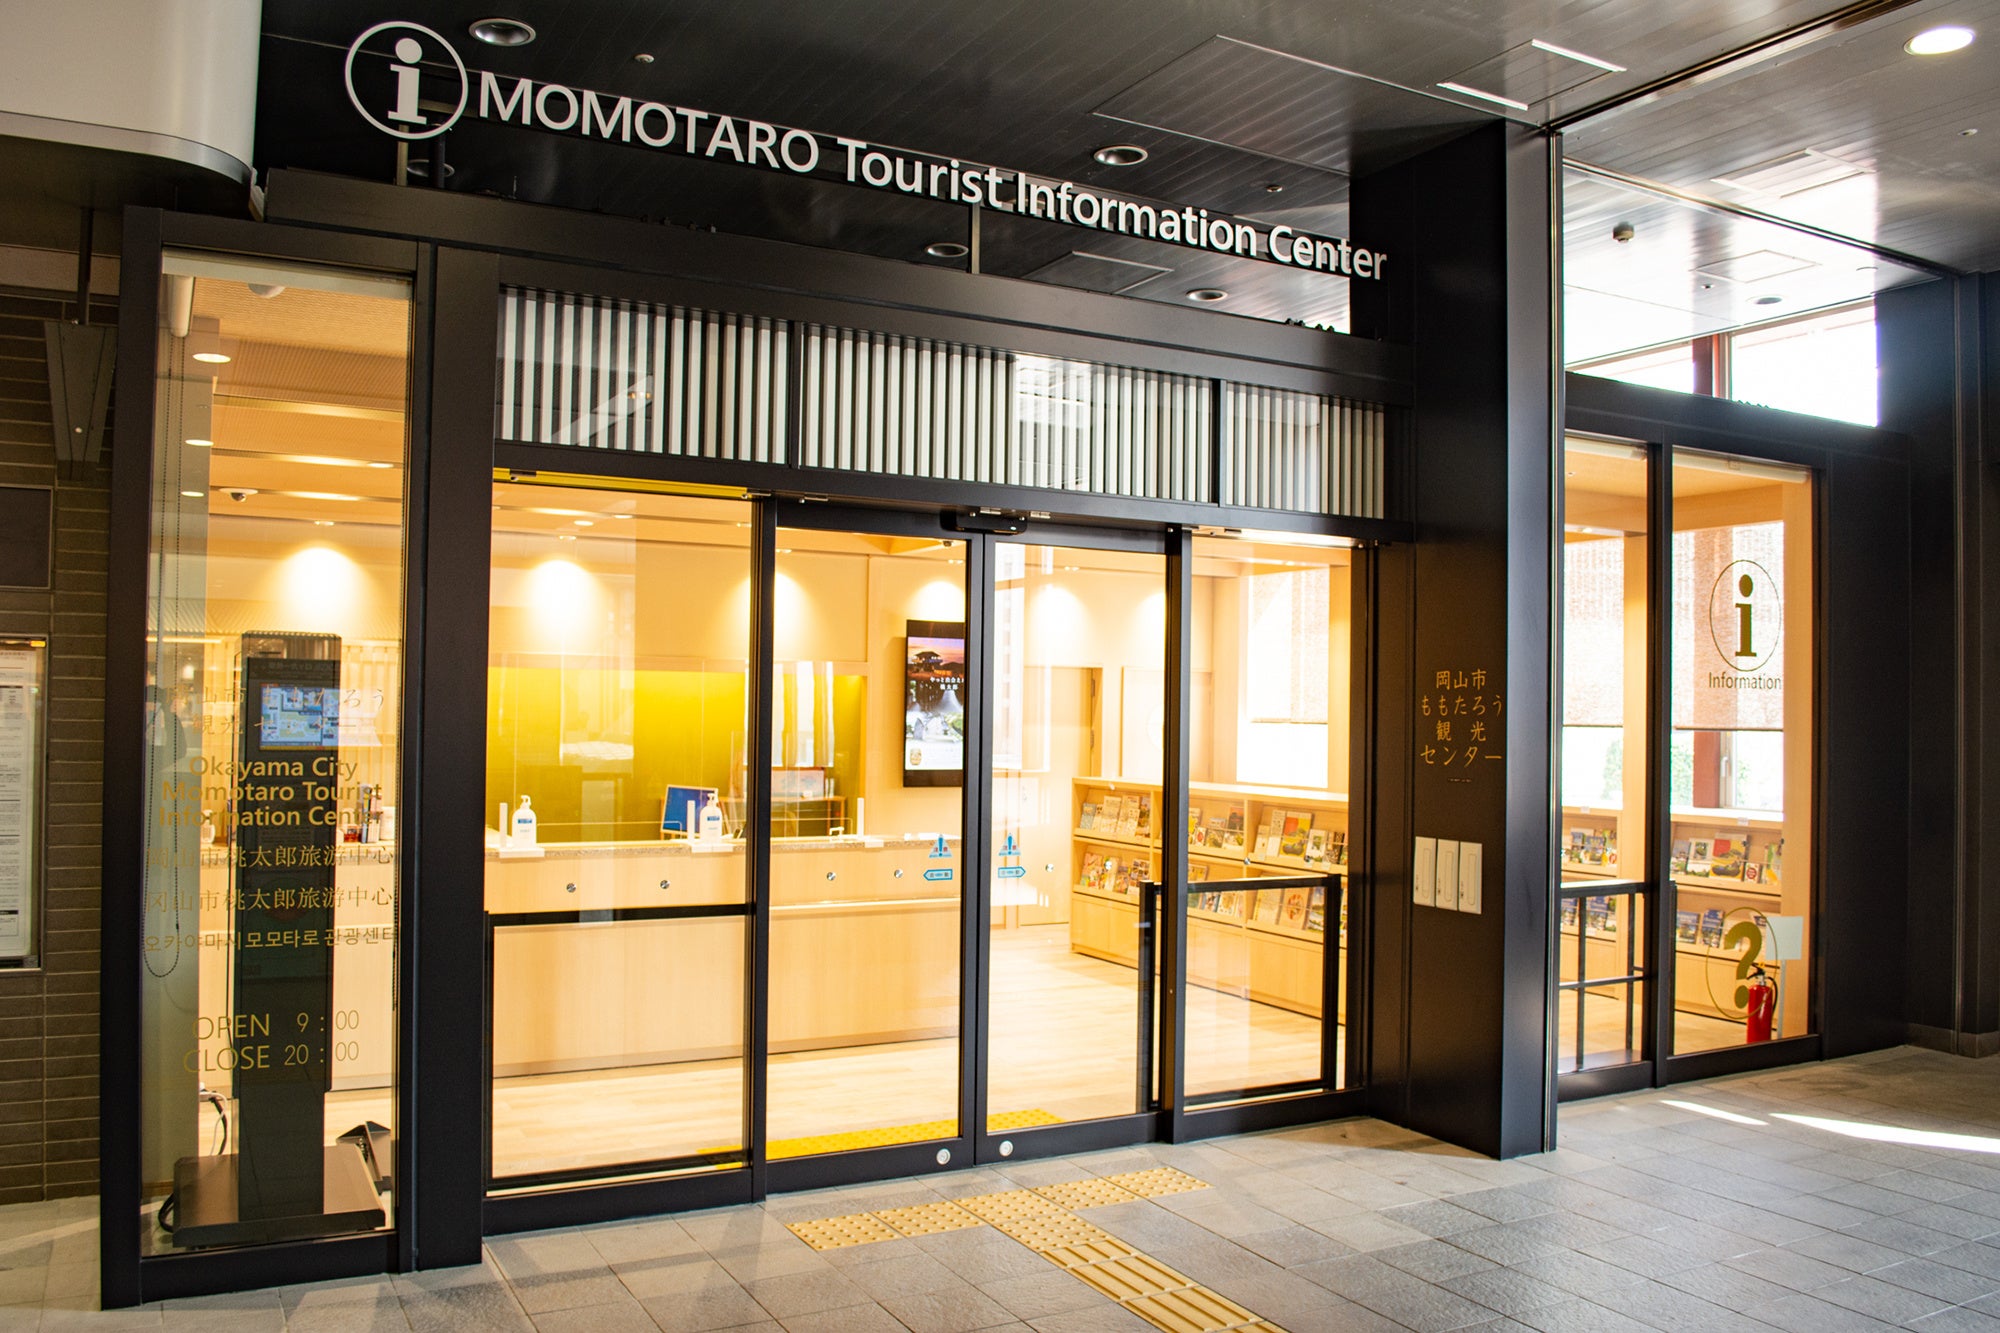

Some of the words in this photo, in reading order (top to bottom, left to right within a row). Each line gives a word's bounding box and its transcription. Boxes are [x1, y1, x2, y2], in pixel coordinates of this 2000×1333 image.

[479, 70, 819, 174] MOMOTARO
[837, 137, 1002, 208] Tourist
[1013, 172, 1258, 256] Information
[1268, 226, 1388, 281] Center
[1436, 669, 1487, 691] 岡山市
[1709, 671, 1782, 690] Information
[1421, 694, 1502, 718] ももたろう
[1420, 744, 1502, 768] センター
[189, 757, 304, 781] Okayama
[311, 756, 358, 781] City
[162, 780, 295, 801] Momotaro
[302, 780, 382, 801] Tourist
[159, 804, 301, 827] Information
[308, 805, 383, 827] Center
[244, 928, 320, 949] 모모타로
[192, 1014, 271, 1041] OPEN
[183, 1045, 271, 1073] CLOSE
